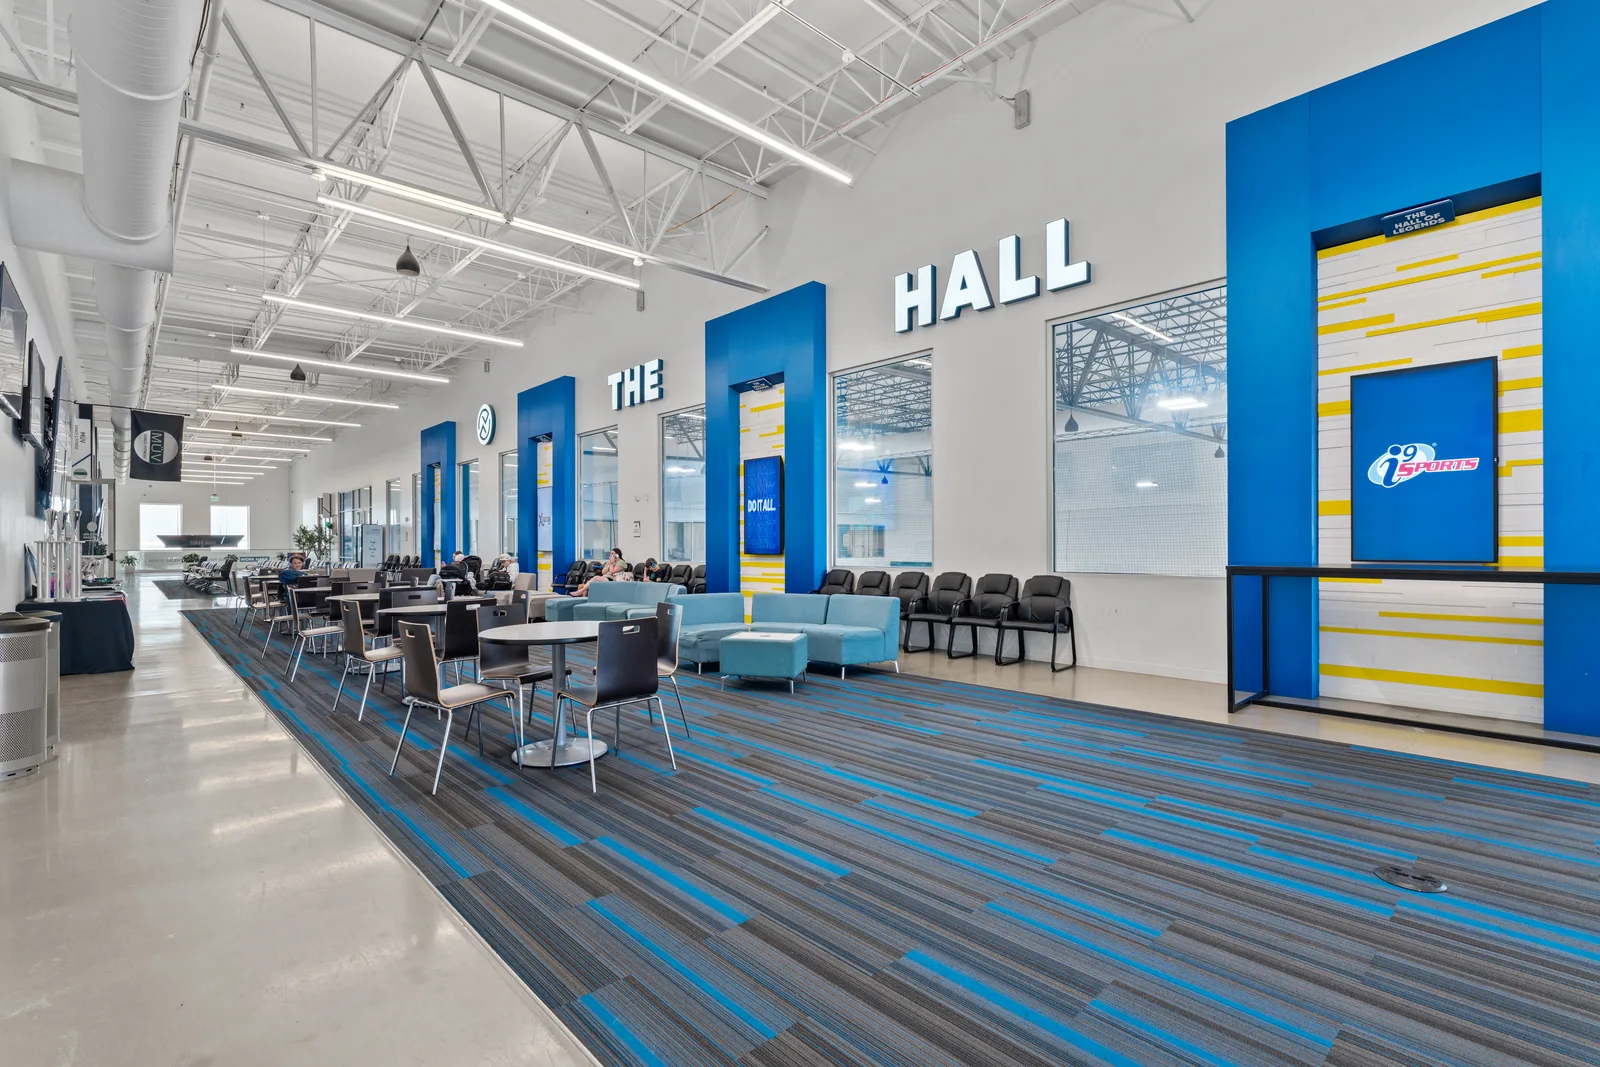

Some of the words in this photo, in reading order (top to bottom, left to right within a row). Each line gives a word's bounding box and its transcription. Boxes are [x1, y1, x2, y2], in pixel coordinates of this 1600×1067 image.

[1394, 218, 1422, 229] HALL
[1424, 212, 1440, 221] OF
[1405, 210, 1426, 220] THE
[1392, 217, 1446, 235] LEGENDS
[895, 217, 1092, 334] HALL
[608, 358, 664, 411] THE
[150, 432, 164, 462] MÜV
[1397, 458, 1478, 477] SPORTS
[747, 499, 757, 512] DO
[757, 499, 763, 511] IT
[762, 498, 776, 511] ALL.
